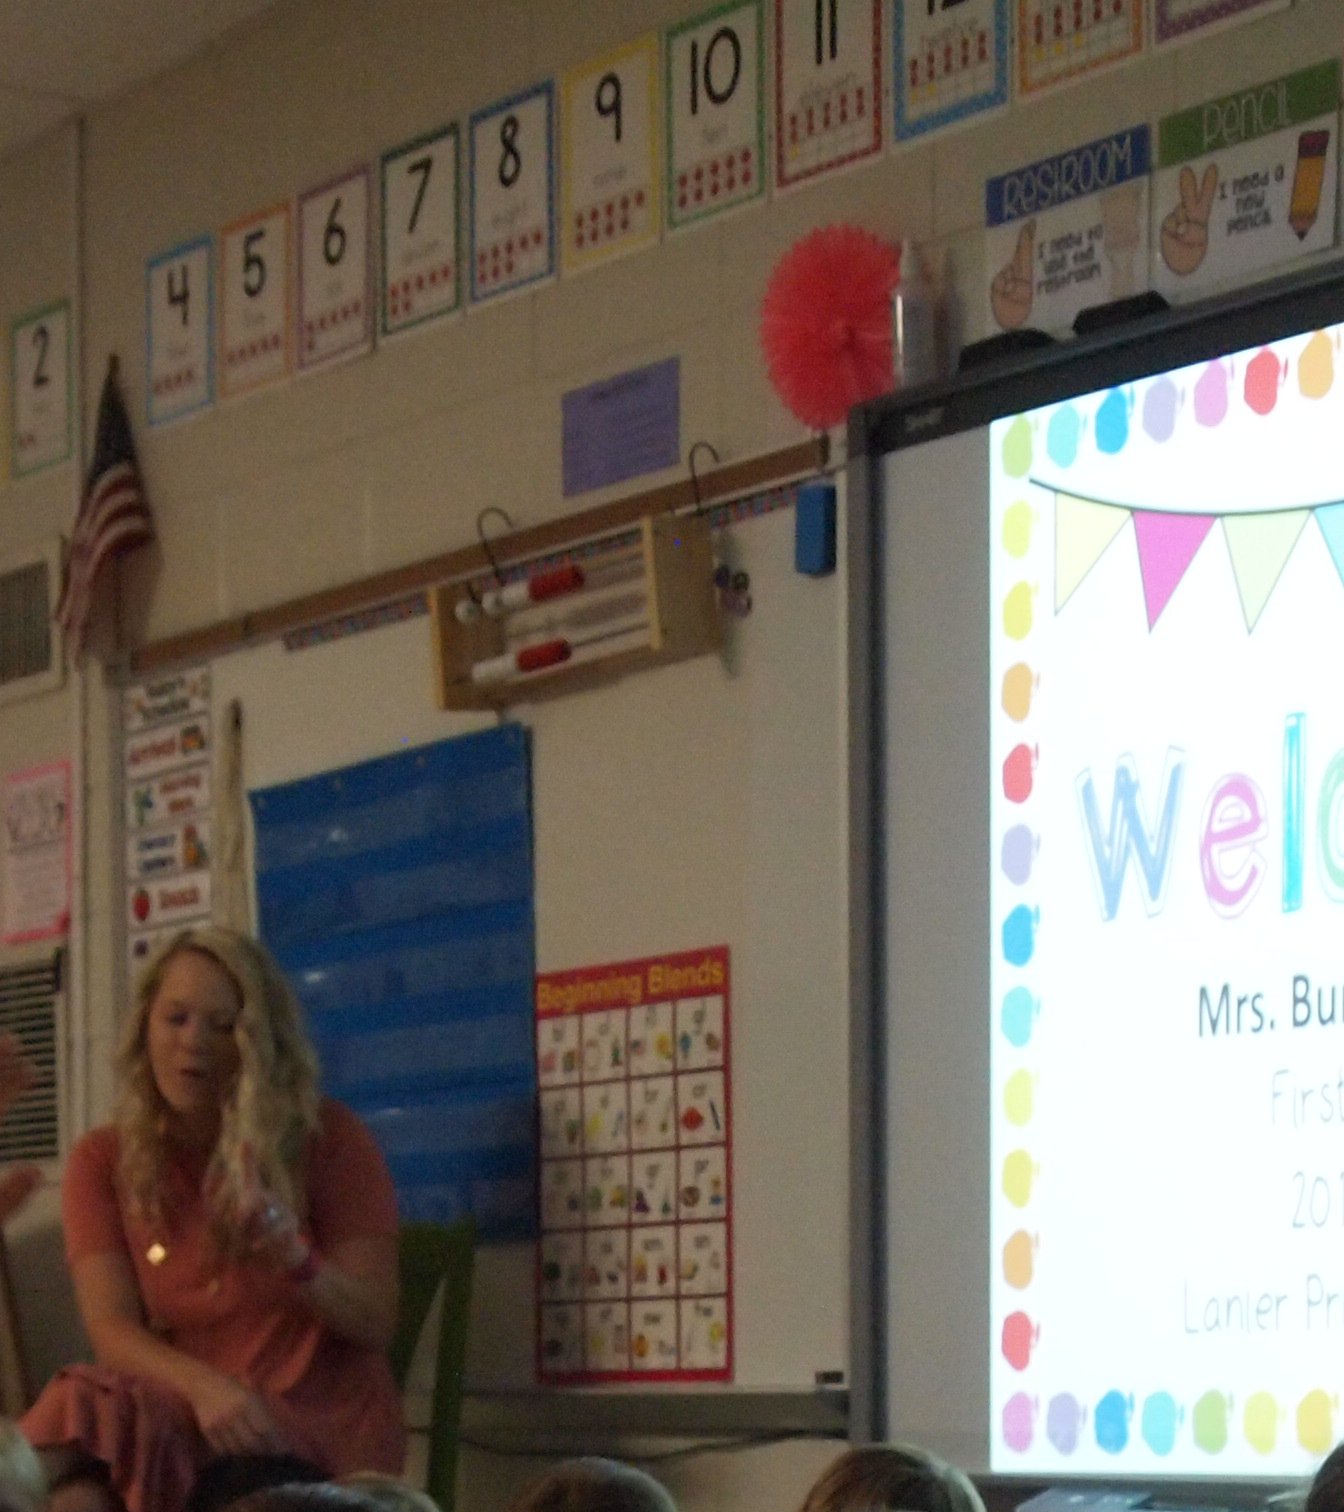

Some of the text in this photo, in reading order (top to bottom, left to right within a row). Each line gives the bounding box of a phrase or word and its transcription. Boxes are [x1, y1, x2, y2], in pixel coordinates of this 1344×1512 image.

[691, 26, 741, 116] 10
[595, 71, 623, 142] 9
[499, 115, 521, 187] 8
[407, 157, 432, 234] 7
[243, 228, 266, 298] 5
[323, 198, 347, 266] 6
[167, 265, 190, 326] 4
[32, 325, 50, 389] 2
[537, 957, 726, 1014] Beginning Blends
[1198, 982, 1275, 1038] Mrs.
[1184, 1278, 1287, 1335] Lanier
